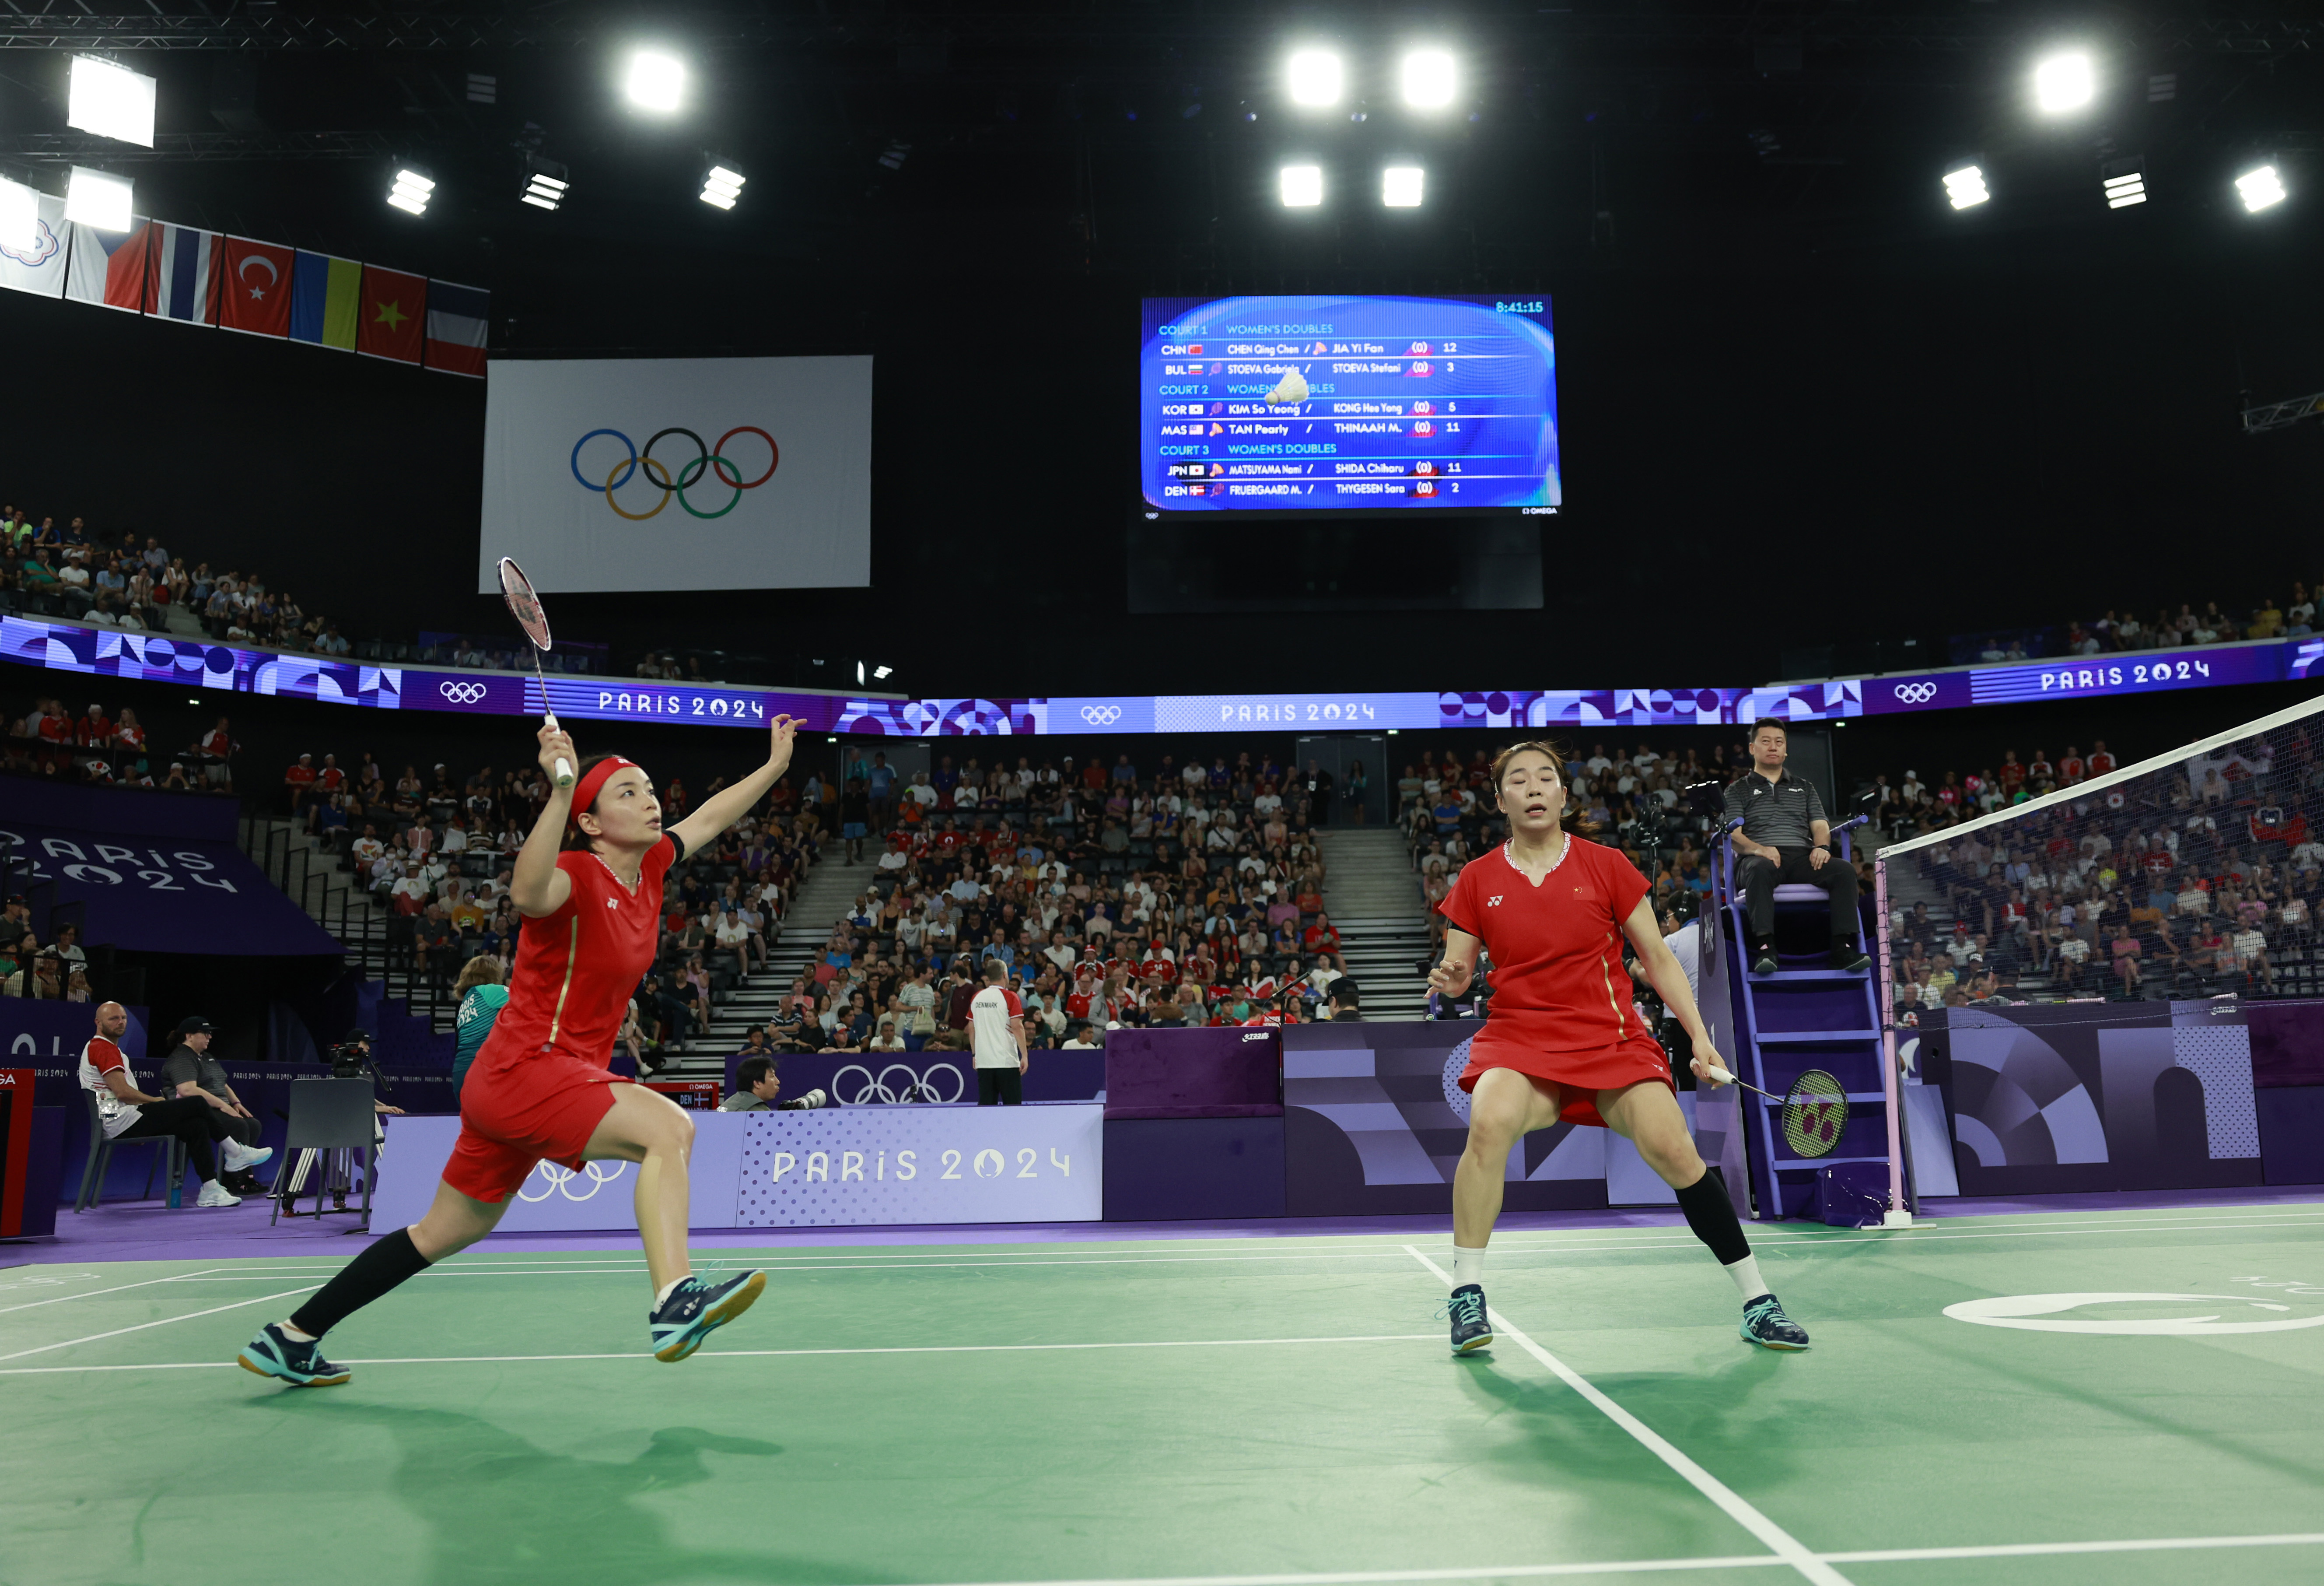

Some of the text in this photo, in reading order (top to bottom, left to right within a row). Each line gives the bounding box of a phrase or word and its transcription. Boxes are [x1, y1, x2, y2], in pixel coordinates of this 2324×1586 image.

[1496, 301, 1543, 312] 8:41:15
[1158, 325, 1208, 336] COURT 1
[1226, 323, 1333, 335] WOMEN'S DOUBLES
[1161, 344, 1186, 355] CHN
[1227, 344, 1253, 354] CHEN
[1254, 344, 1275, 356] Qing
[1276, 344, 1299, 354] Chen
[1332, 344, 1349, 354] JIA
[1351, 344, 1362, 353] Yi
[1364, 343, 1384, 353] Fan
[1411, 341, 1428, 354] (0)
[1443, 342, 1457, 353] 12
[1165, 365, 1187, 375] BUL
[1227, 364, 1262, 375] STOEVA
[1263, 364, 1299, 375] Gabriela
[1333, 363, 1369, 373] STOEVA
[1370, 362, 1401, 373] Stefani
[1412, 361, 1428, 373] (0)
[1447, 362, 1454, 372] 3
[1159, 384, 1209, 396] COURT 2
[1227, 384, 1278, 395] WOMEN'
[1162, 405, 1187, 416] KOR
[1228, 404, 1250, 415] KIM
[1252, 404, 1266, 414] So
[1267, 404, 1300, 417] Yeong
[1334, 403, 1362, 413] KONG
[1363, 403, 1379, 413] Hee
[1380, 403, 1402, 415] Yong
[1414, 401, 1430, 413] (0)
[1449, 402, 1456, 412] 5
[1161, 425, 1187, 435] MAS
[1228, 425, 1253, 435] TAN
[1255, 424, 1289, 436] Pearly
[1334, 423, 1386, 433] THINAAH
[1387, 423, 1402, 432] M.
[1414, 421, 1431, 433] (0)
[1446, 422, 1460, 432] 11
[1159, 445, 1209, 456] COURT 3
[1227, 443, 1337, 455] WOMEN'S DOUBLES
[1167, 465, 1187, 476] JPN
[1228, 464, 1281, 475] MATSUYAMA
[1282, 464, 1302, 474] Nami
[1335, 463, 1366, 474] SHIDA
[1366, 463, 1404, 473] Chiharu
[1415, 461, 1432, 474] (0)
[1448, 463, 1461, 473] 11
[1165, 486, 1187, 496] DEN
[1229, 484, 1288, 495] FRUERGAARD
[1290, 484, 1302, 495] M.
[1336, 484, 1383, 494] THYGESEN
[1384, 484, 1405, 494] Sara
[1416, 481, 1433, 495] (0)
[1452, 483, 1459, 493] 2
[2133, 659, 2210, 684] 2024
[692, 698, 764, 719] 2024
[1306, 702, 1375, 721] 2024
[458, 993, 474, 1016] ARIS
[680, 1095, 692, 1105] DEN
[940, 1147, 1071, 1180] 2024
